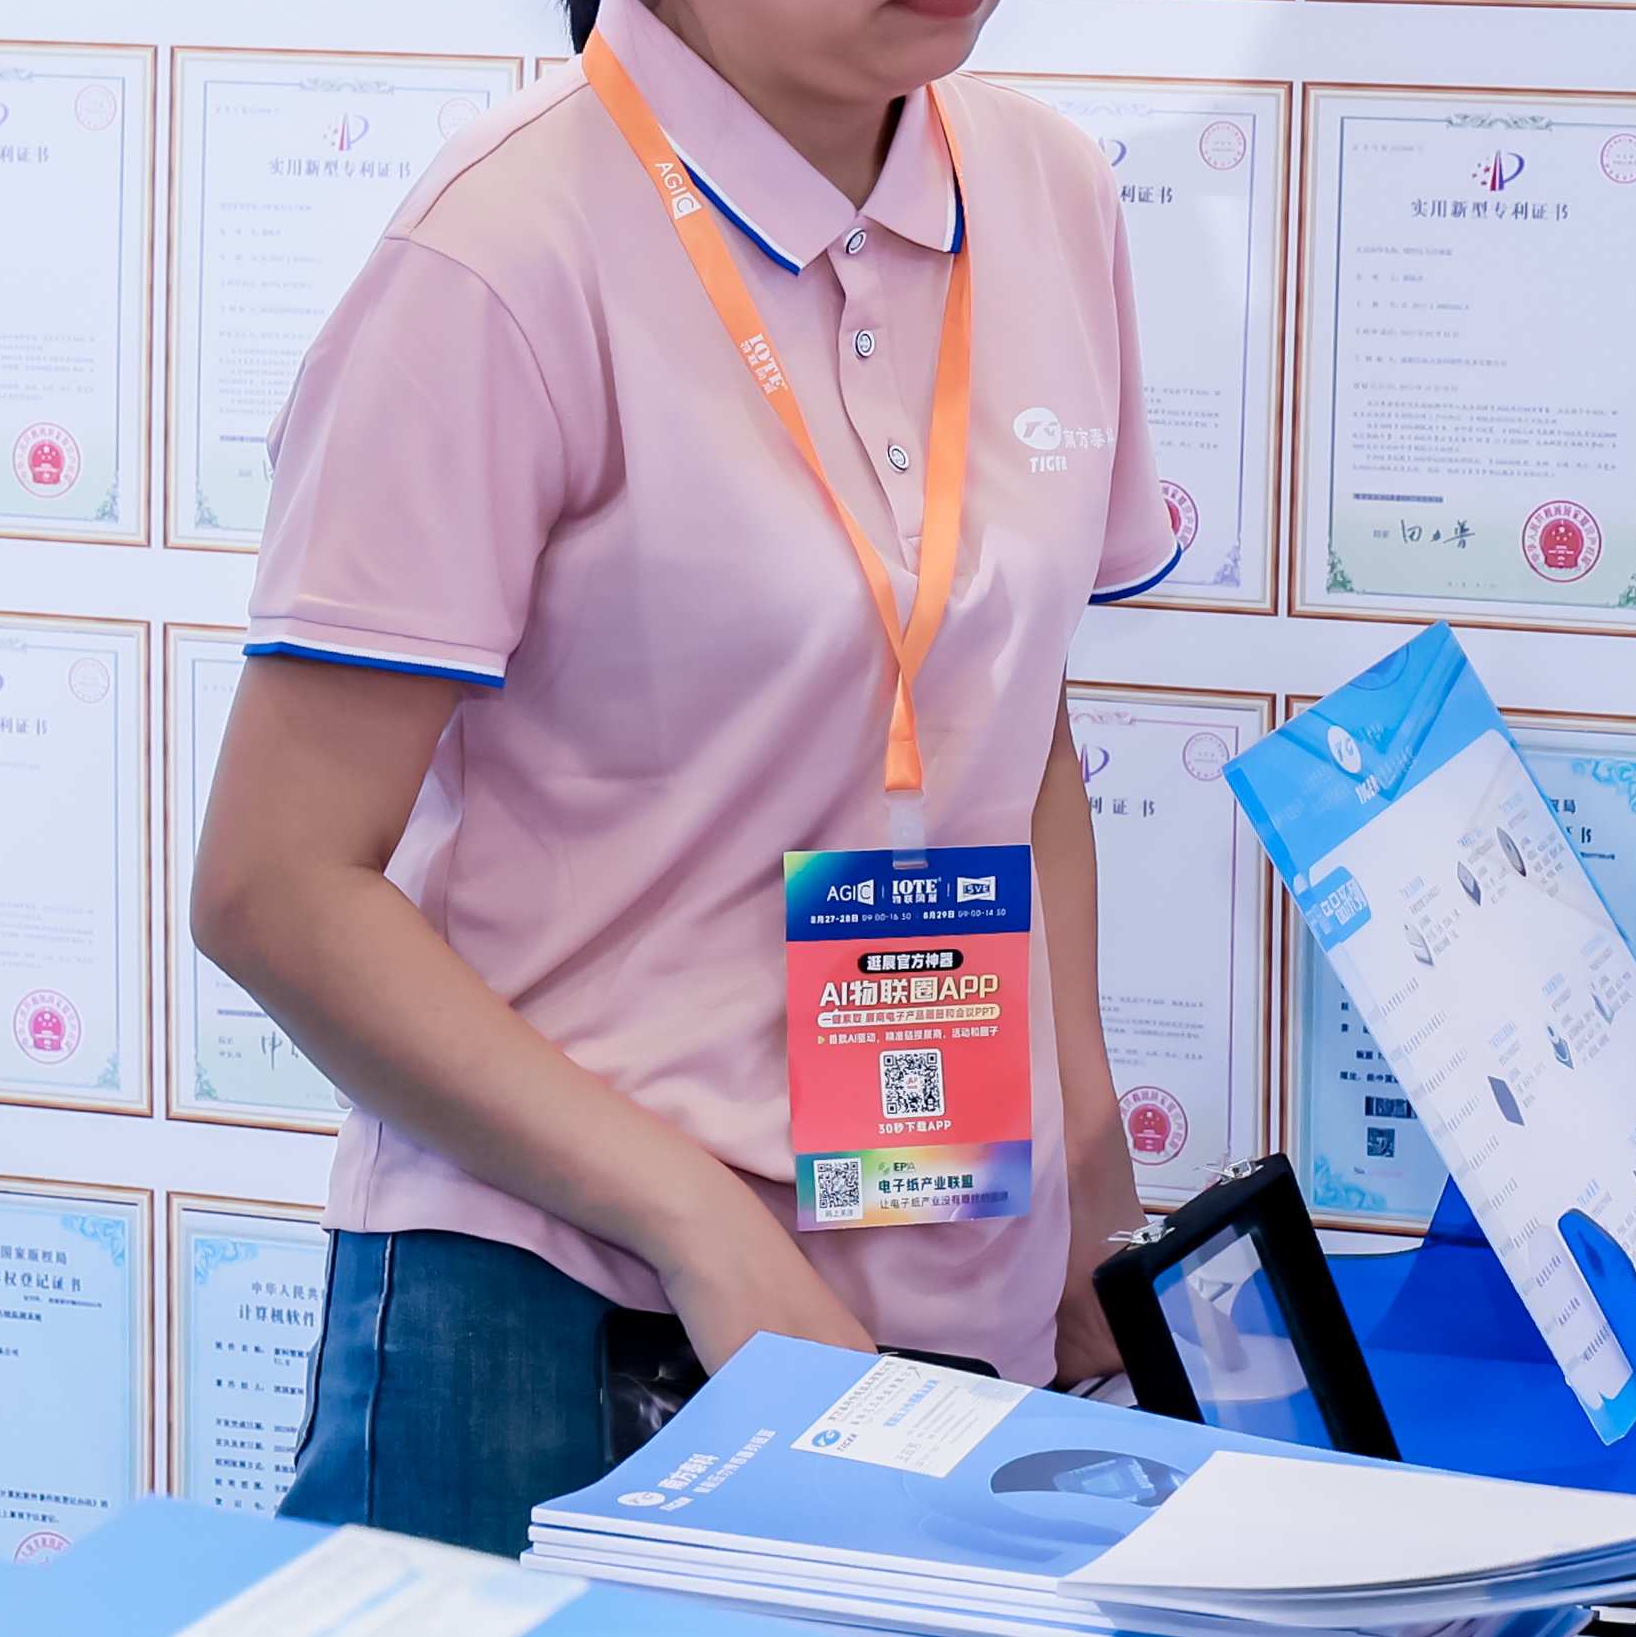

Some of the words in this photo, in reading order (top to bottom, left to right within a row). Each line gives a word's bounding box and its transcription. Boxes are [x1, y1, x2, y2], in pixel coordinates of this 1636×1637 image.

[269, 155, 413, 180] 实用新型专利证书
[654, 160, 701, 220] AGIC
[1411, 198, 1569, 221] 实用新型专利证书
[747, 332, 787, 391] IOTE
[826, 879, 875, 905] AGIC
[891, 878, 938, 895] IOTE
[866, 952, 953, 971] 逛展官方神器
[819, 974, 999, 1007] AI物联圈APP
[878, 1174, 974, 1194] 电子纸产业联盟
[239, 1304, 315, 1328] 计算机软件
